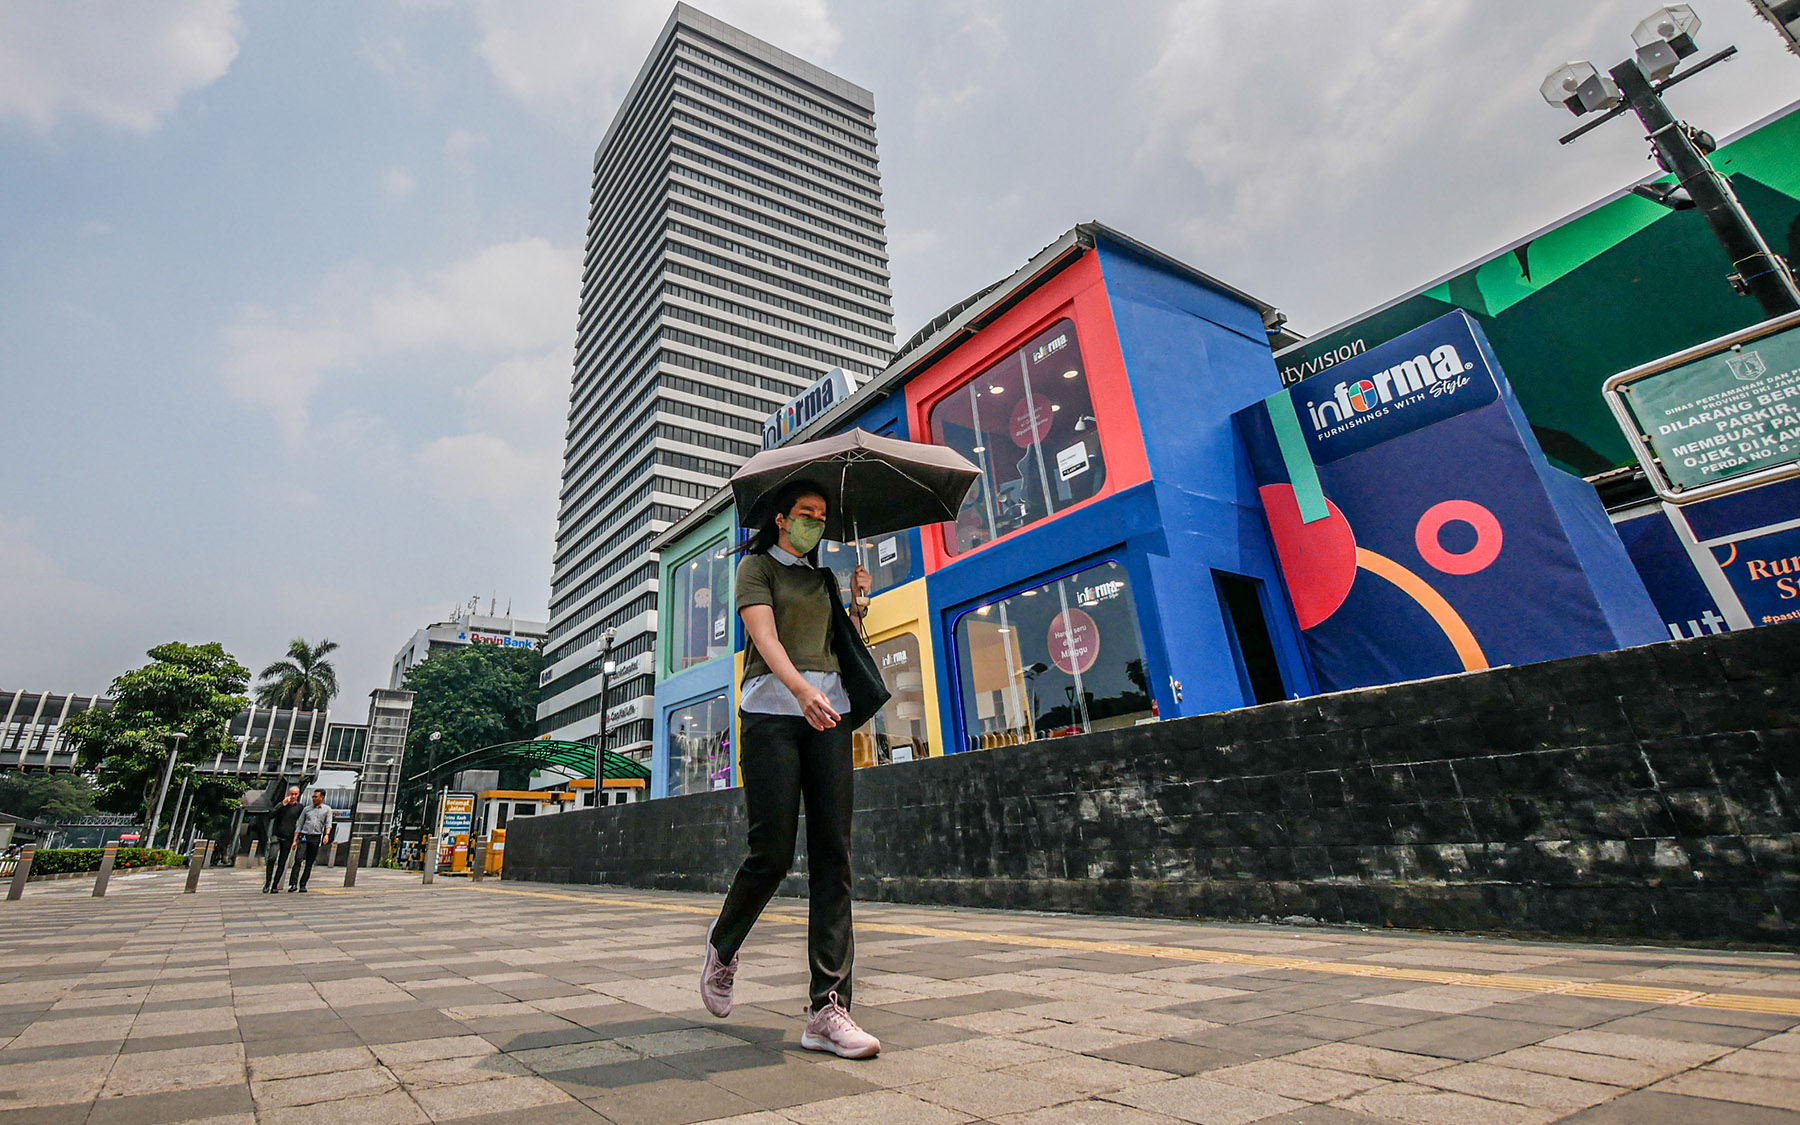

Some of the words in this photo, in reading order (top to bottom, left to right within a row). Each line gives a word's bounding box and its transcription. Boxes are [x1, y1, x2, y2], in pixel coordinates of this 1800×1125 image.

[1306, 344, 1465, 431] informa
[1664, 403, 1694, 416] DINAS
[1696, 381, 1764, 405] PERTAMANAN
[1766, 373, 1789, 384] DAN
[1702, 392, 1750, 411] PROVINSI
[1752, 385, 1771, 395] DKI
[762, 377, 834, 451] informa
[1318, 407, 1390, 441] FURNISHINGS
[1394, 392, 1426, 410] WITH
[1429, 375, 1471, 398] Style
[1658, 400, 1753, 436] DILARANG
[1715, 403, 1798, 432] PARKIR,
[1671, 422, 1766, 457] MEMBUAT
[1770, 412, 1800, 430] PA
[1683, 446, 1735, 468] OJEK
[1700, 457, 1749, 475] PERDA
[1750, 448, 1777, 461] NO.
[1779, 443, 1790, 453] 8
[1076, 580, 1119, 604] informa
[1073, 625, 1087, 634] seru
[1061, 646, 1088, 658] Miggu
